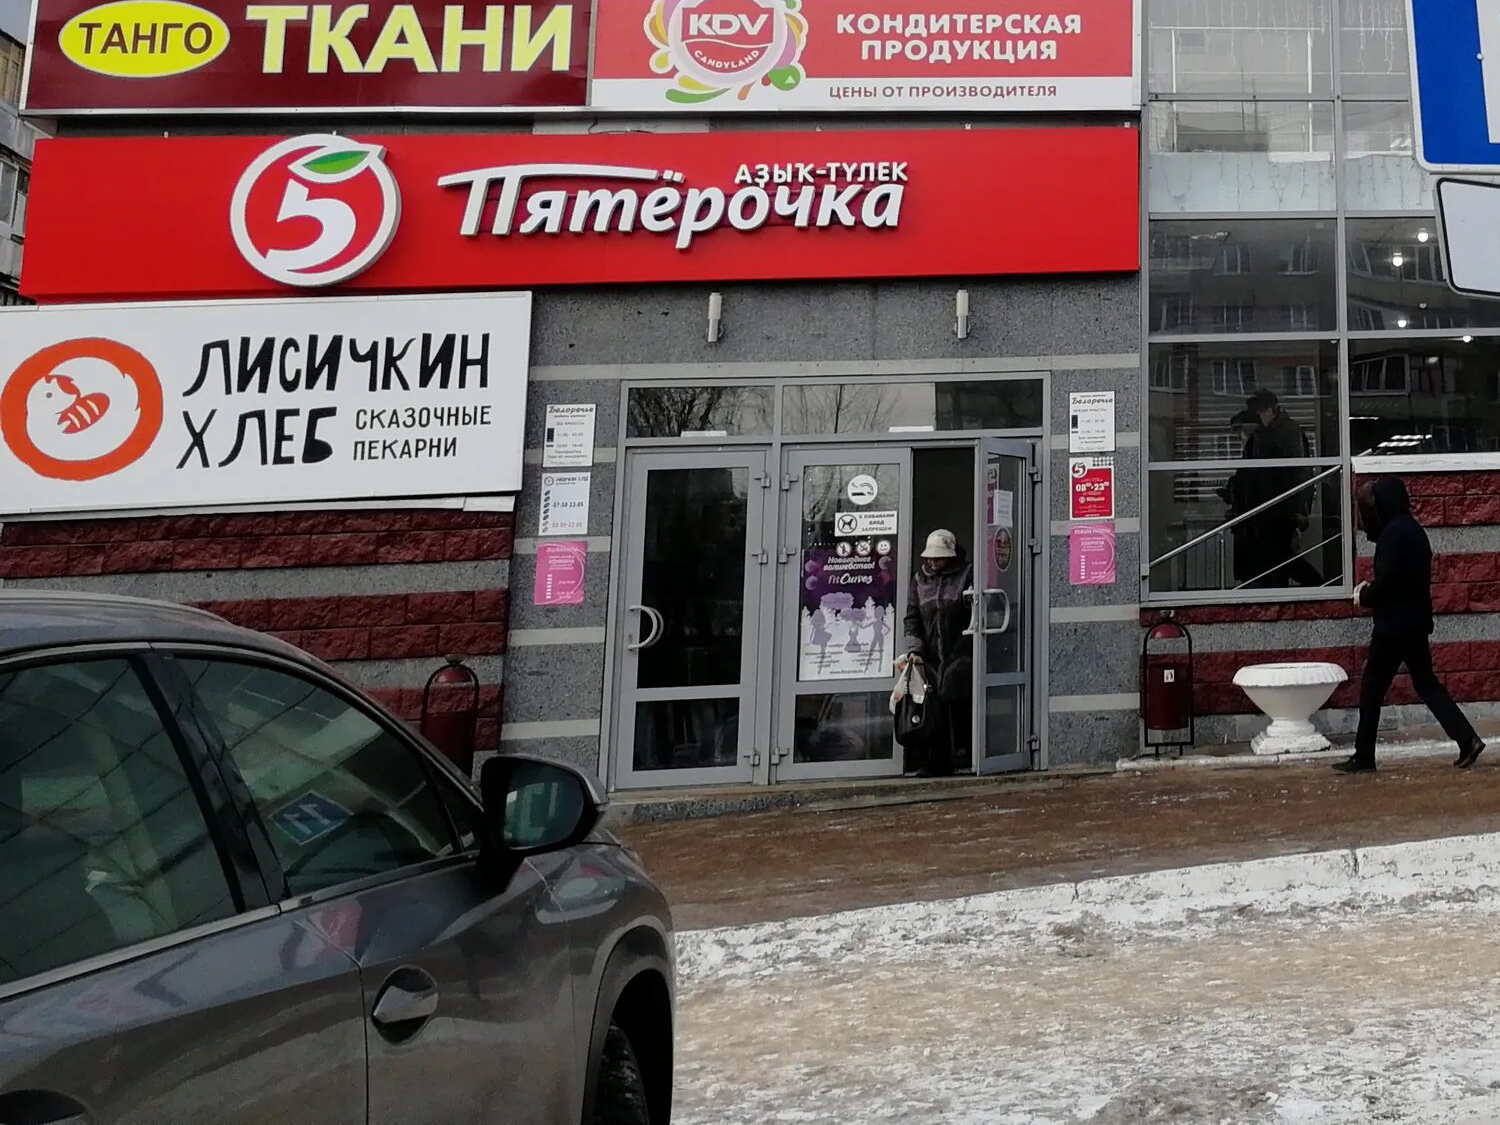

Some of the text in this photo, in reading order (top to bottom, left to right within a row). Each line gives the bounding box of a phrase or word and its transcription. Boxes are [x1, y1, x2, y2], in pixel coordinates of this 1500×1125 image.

[689, 13, 770, 36] KDV
[836, 12, 1082, 37] КОНДИТЕРСКАЯ
[78, 21, 214, 56] ТАНГО
[245, 3, 574, 74] ТКАНИ
[861, 39, 1058, 64] ПРОДУКЦИЯ
[694, 49, 760, 70] CANDYLAND
[828, 84, 1058, 100] ЦЕНЫ ОТ ПРОИЗВОДИТЕЛЯ
[437, 162, 905, 251] Пятёрочка
[182, 332, 491, 398] ЛИСИЧКИН
[354, 404, 492, 431] СКАЗОЧНЫЕ
[176, 407, 338, 468] ХЛЕБ
[352, 436, 458, 462] ПЕКАРНИ
